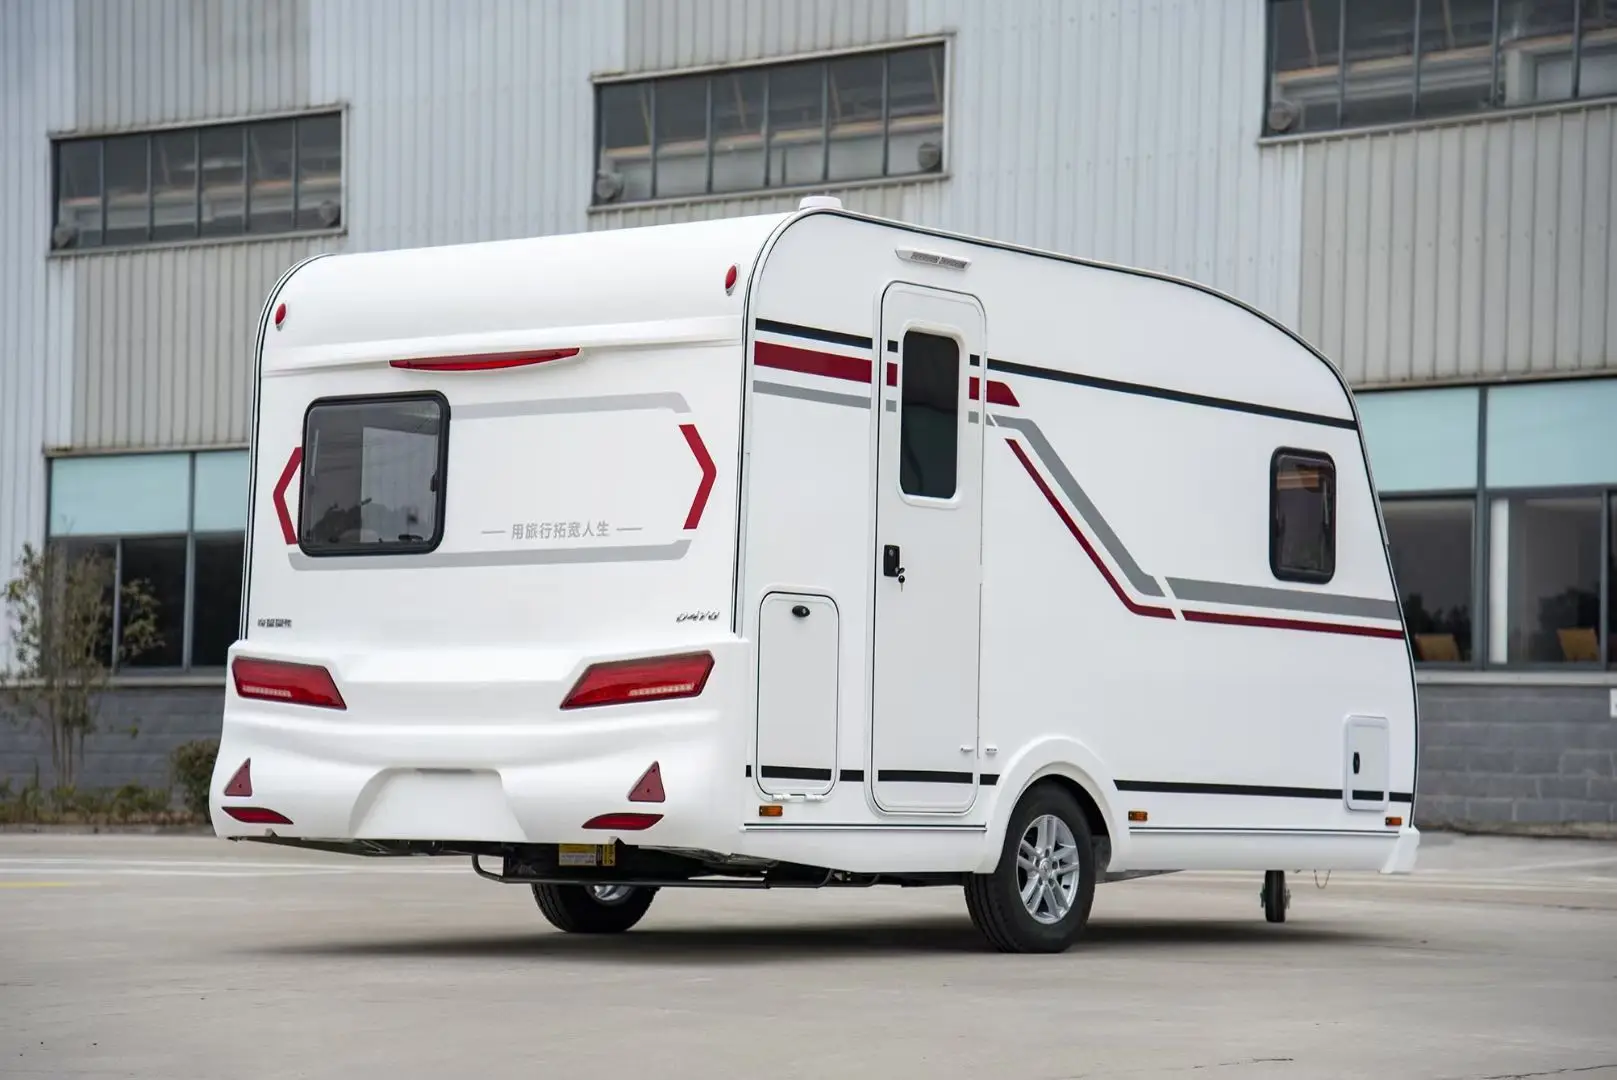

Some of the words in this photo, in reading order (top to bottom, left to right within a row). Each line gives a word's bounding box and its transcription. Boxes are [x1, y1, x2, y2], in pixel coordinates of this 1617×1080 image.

[511, 520, 610, 540] 用旅行拓宽人生
